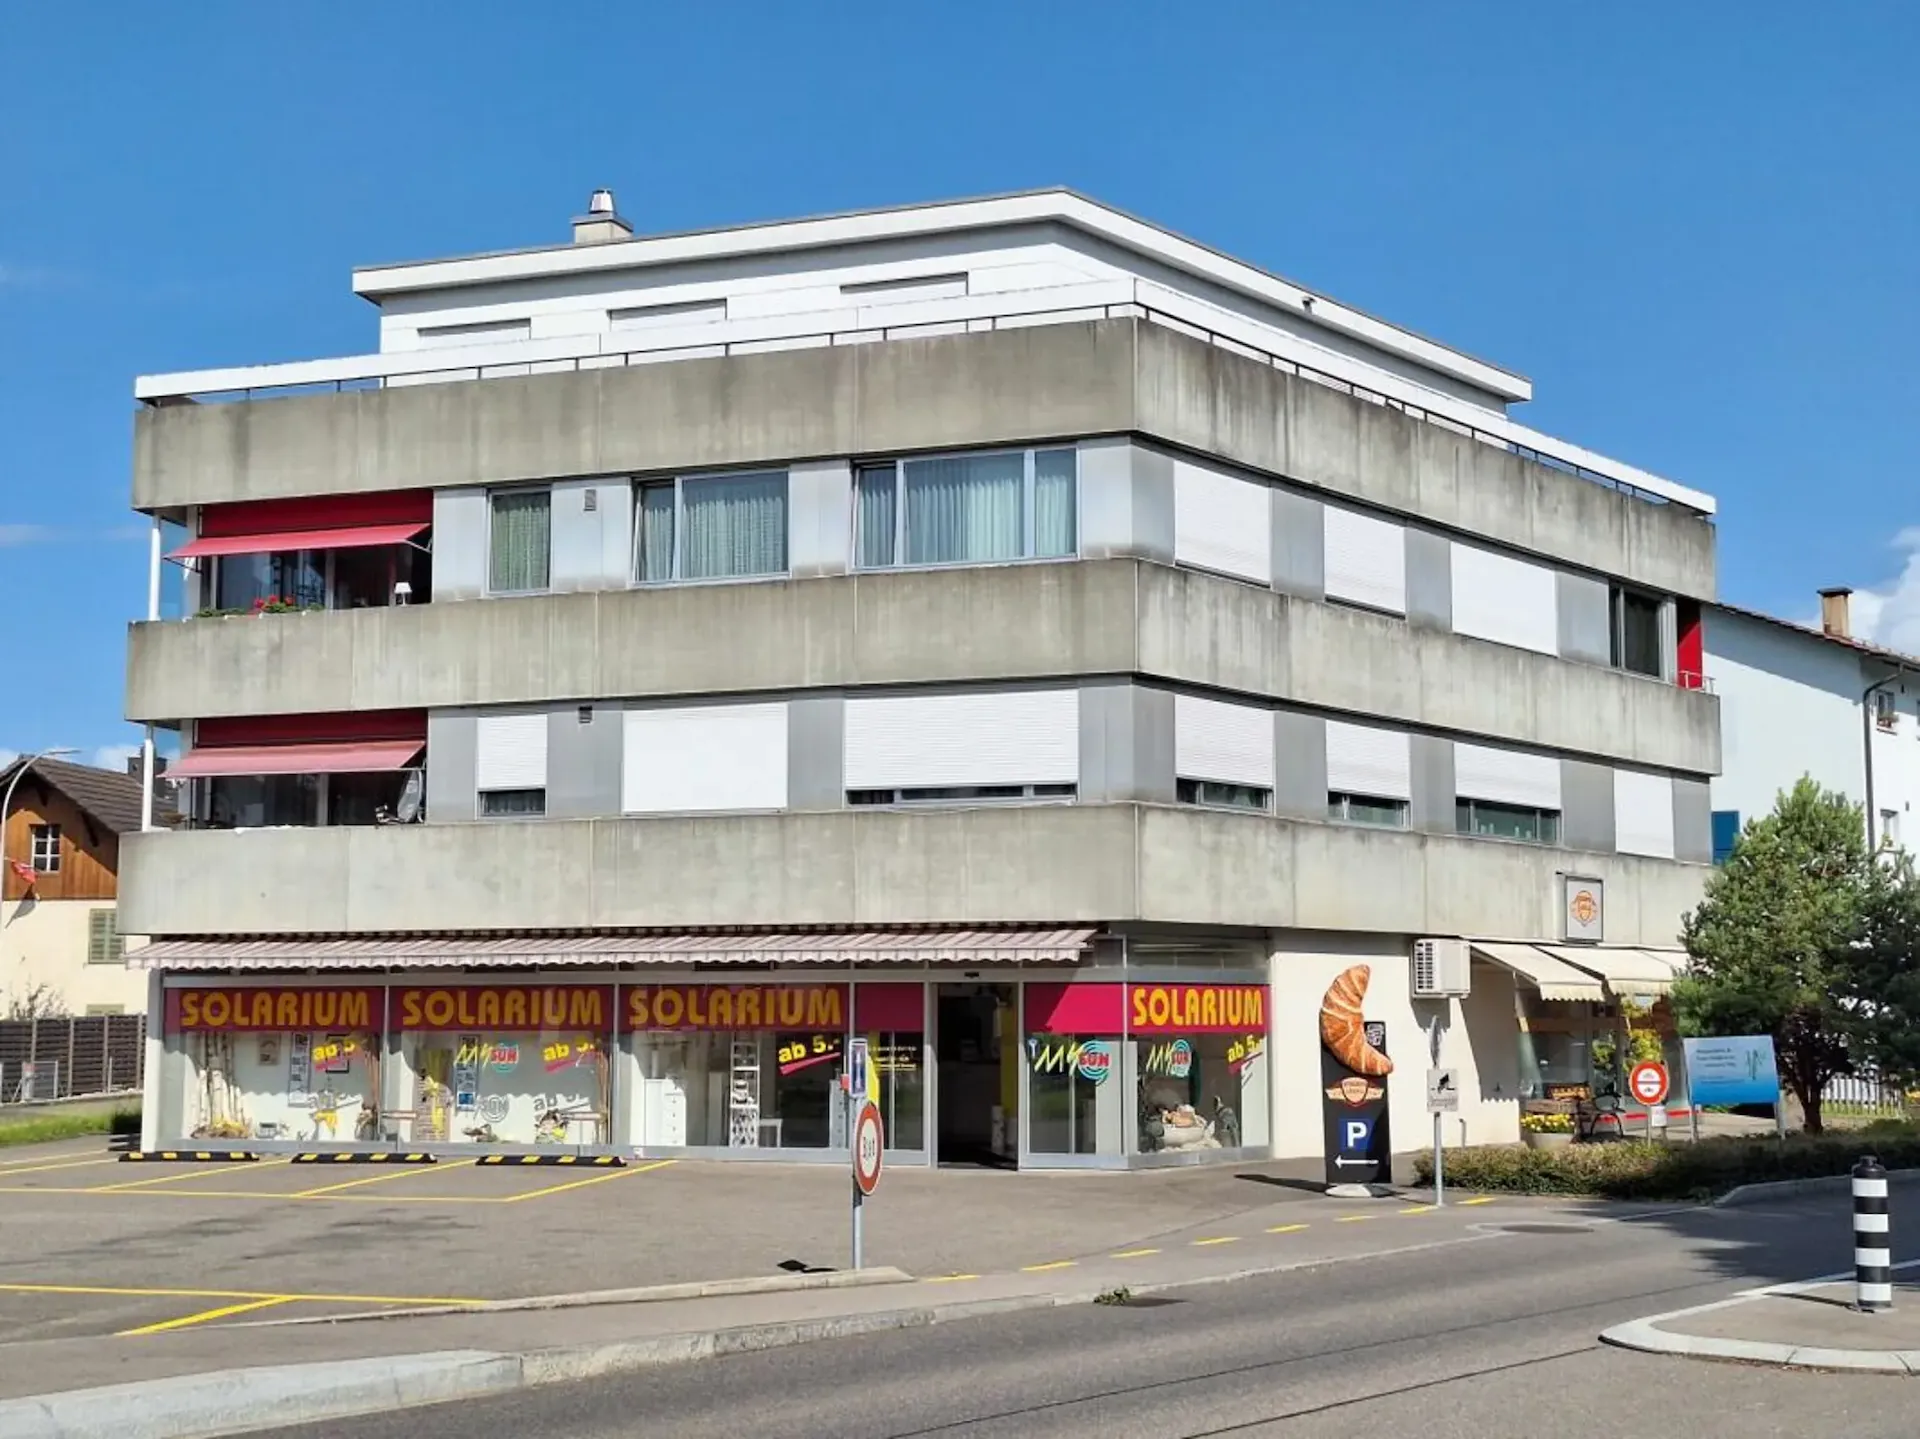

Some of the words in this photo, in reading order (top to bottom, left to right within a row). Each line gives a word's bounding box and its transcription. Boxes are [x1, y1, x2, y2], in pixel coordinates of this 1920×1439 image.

[181, 992, 369, 1026] SOLARIUM
[402, 990, 601, 1026] SOLARIUM
[629, 988, 841, 1026] SOLARIUM
[1133, 988, 1263, 1026] SOLARIUM
[543, 1043, 570, 1062] ab
[778, 1042, 807, 1064] ab
[1227, 1041, 1245, 1063] ab
[1346, 1121, 1367, 1147] P
